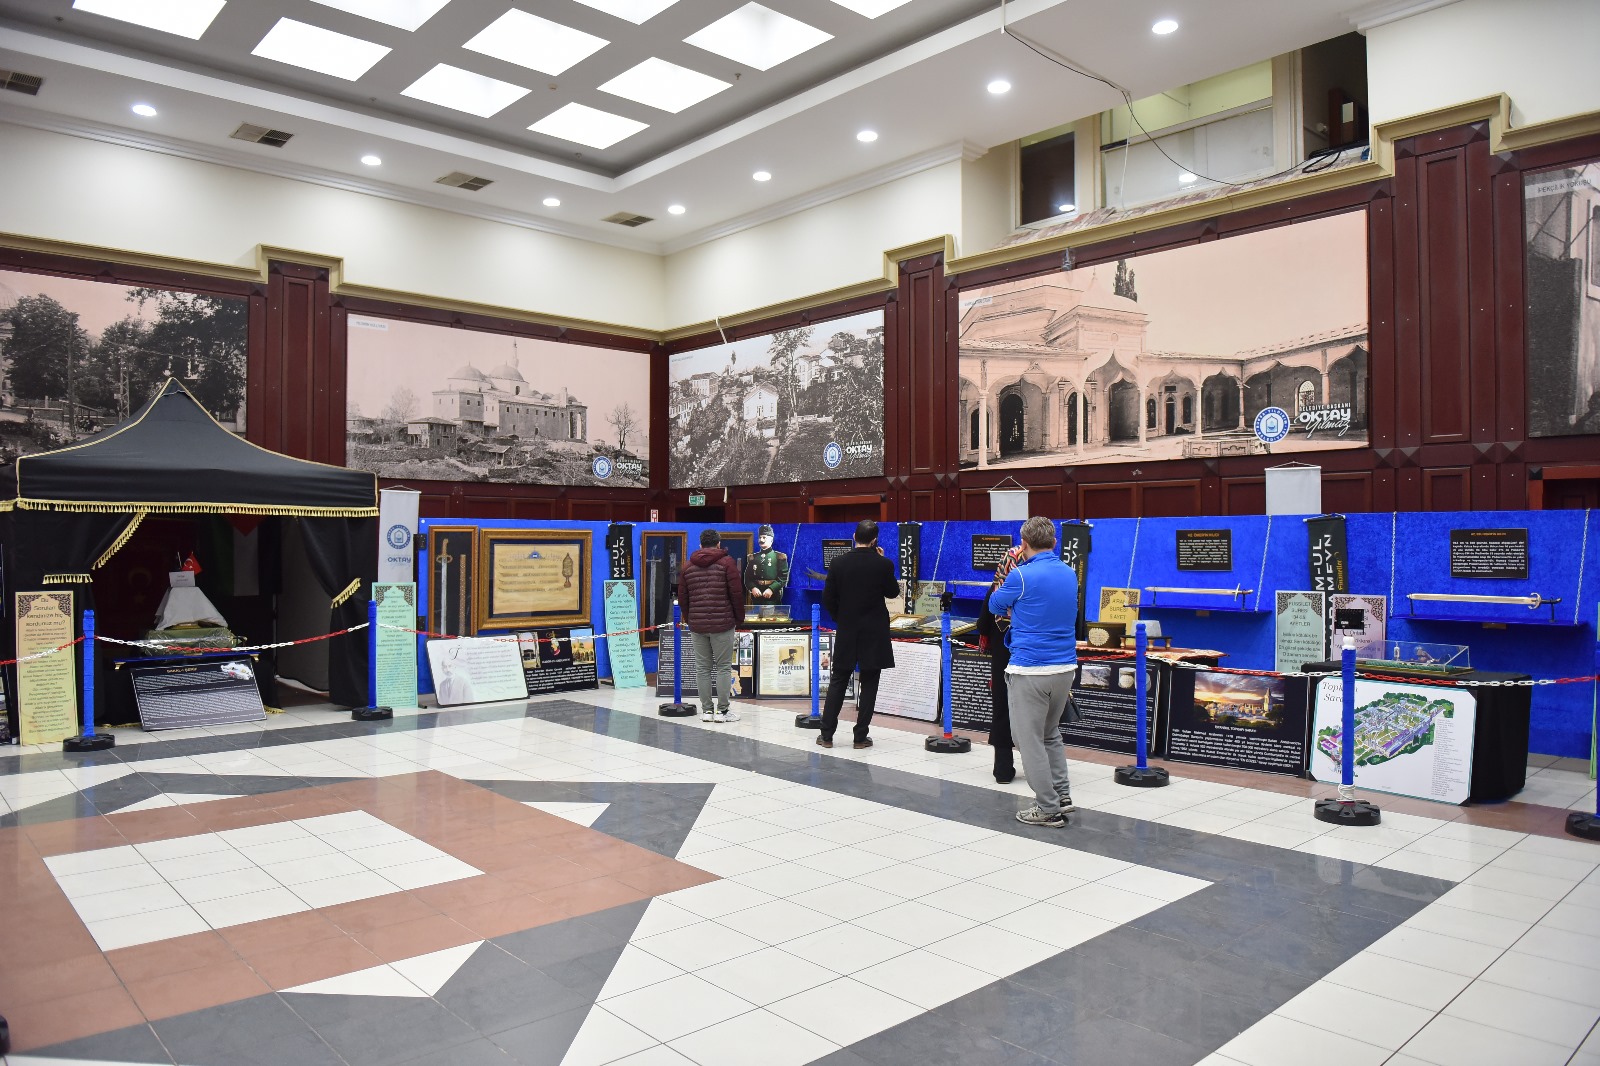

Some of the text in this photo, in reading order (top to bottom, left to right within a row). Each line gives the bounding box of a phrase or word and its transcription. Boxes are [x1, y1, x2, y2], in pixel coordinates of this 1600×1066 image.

[1299, 408, 1351, 423] OKTAY
[845, 444, 873, 454] OKTAY
[616, 463, 643, 472] OKTAY
[387, 556, 412, 564] OKTAY
